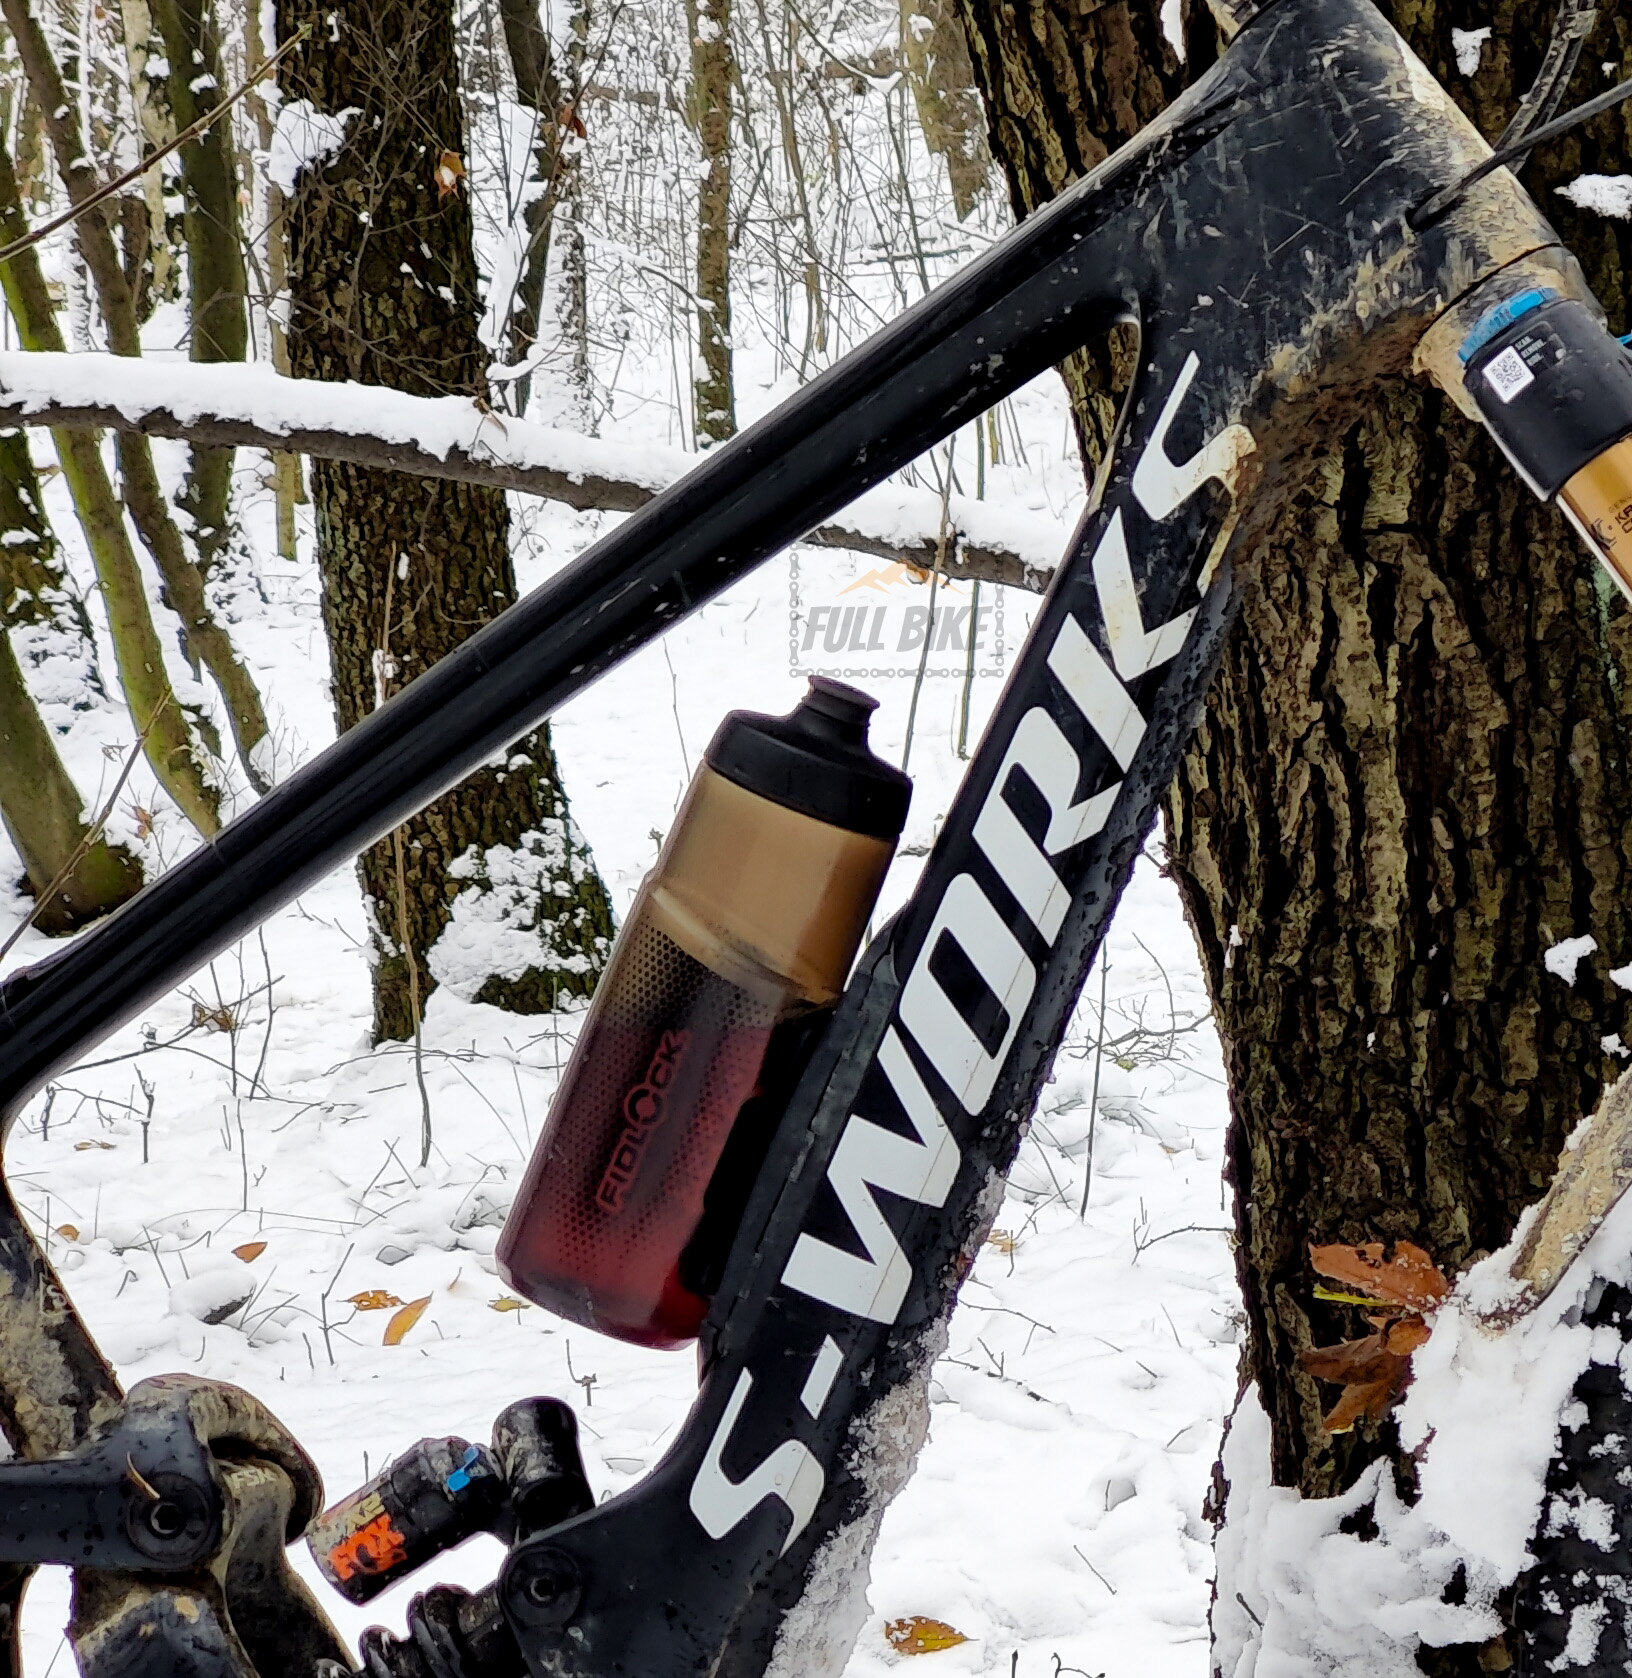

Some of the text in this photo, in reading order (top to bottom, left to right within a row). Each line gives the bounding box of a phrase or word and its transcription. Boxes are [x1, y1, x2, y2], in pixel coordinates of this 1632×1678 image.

[689, 351, 1257, 1559] S-WORKS
[603, 1036, 684, 1208] FIDLOCK
[328, 1513, 407, 1582] FOX
